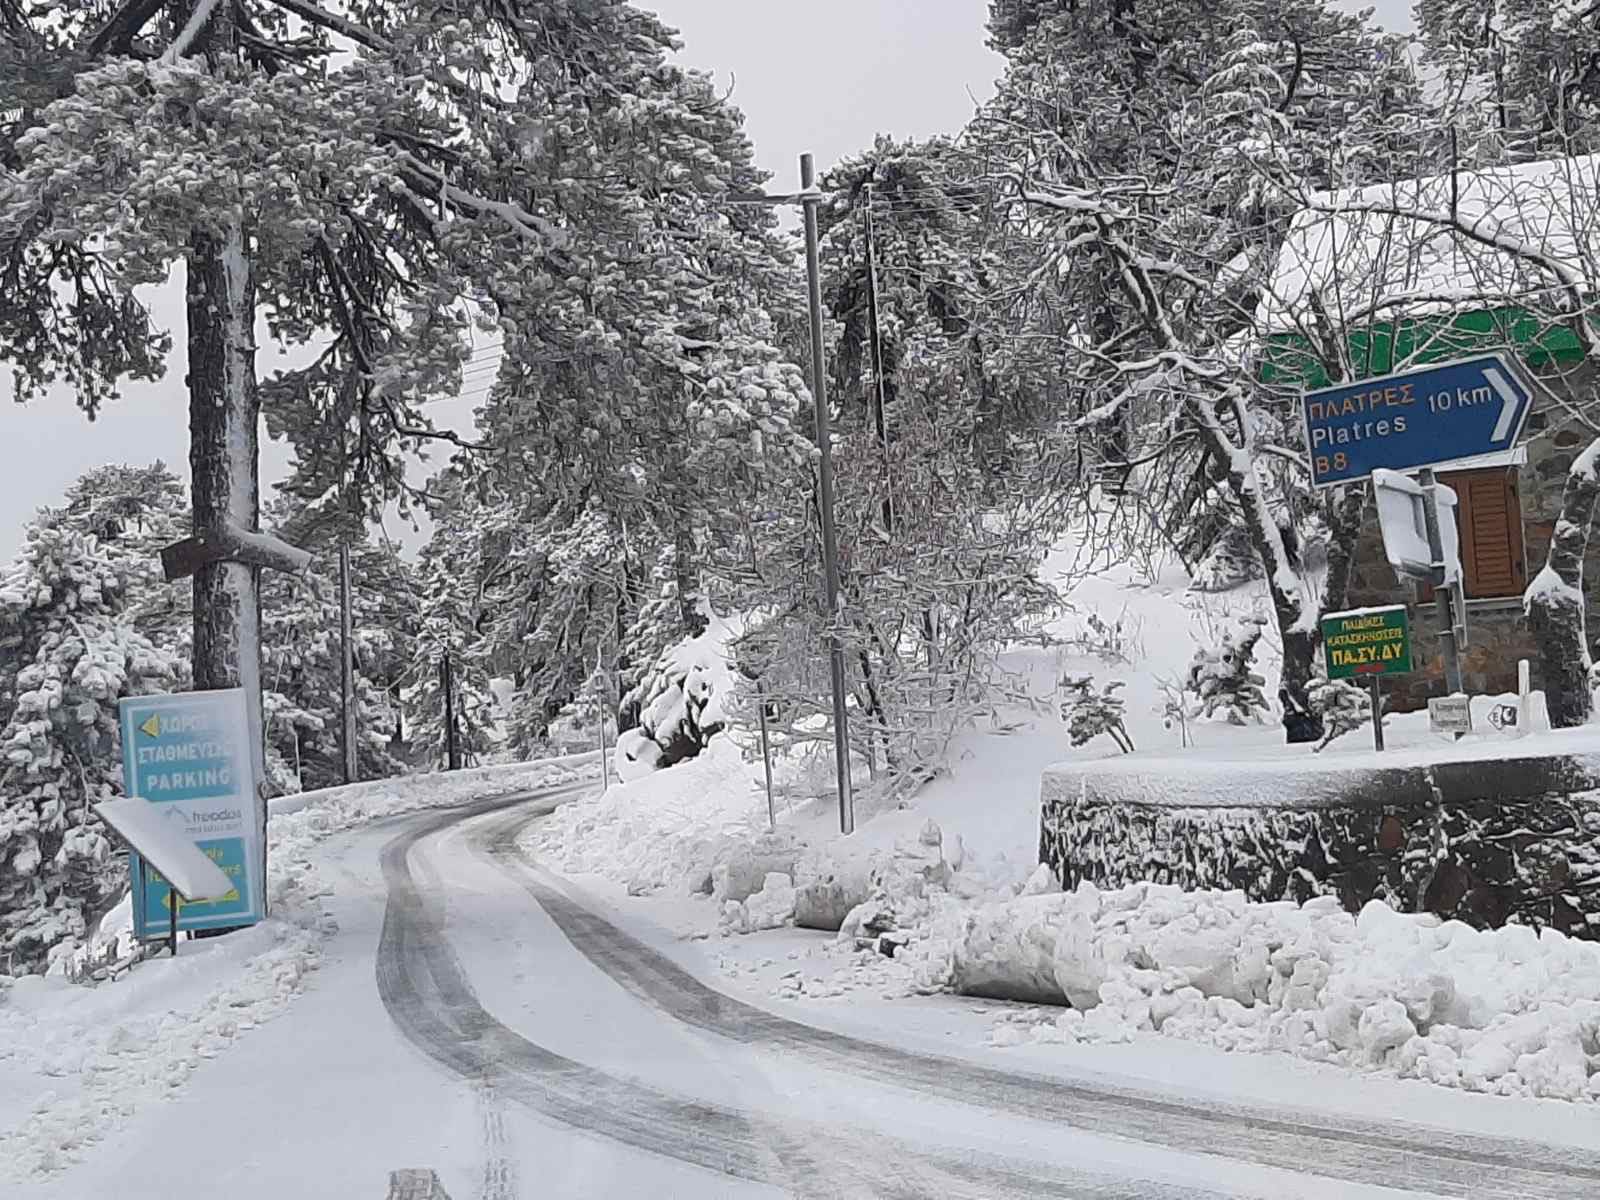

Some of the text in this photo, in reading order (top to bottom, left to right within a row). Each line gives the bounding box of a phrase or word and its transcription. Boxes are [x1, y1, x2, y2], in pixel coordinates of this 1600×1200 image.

[1309, 384, 1415, 421] ΠΛΑΤΡΕΣ
[1428, 386, 1492, 412] 10 km
[1312, 416, 1407, 449] Platres
[147, 769, 230, 792] PARKING
